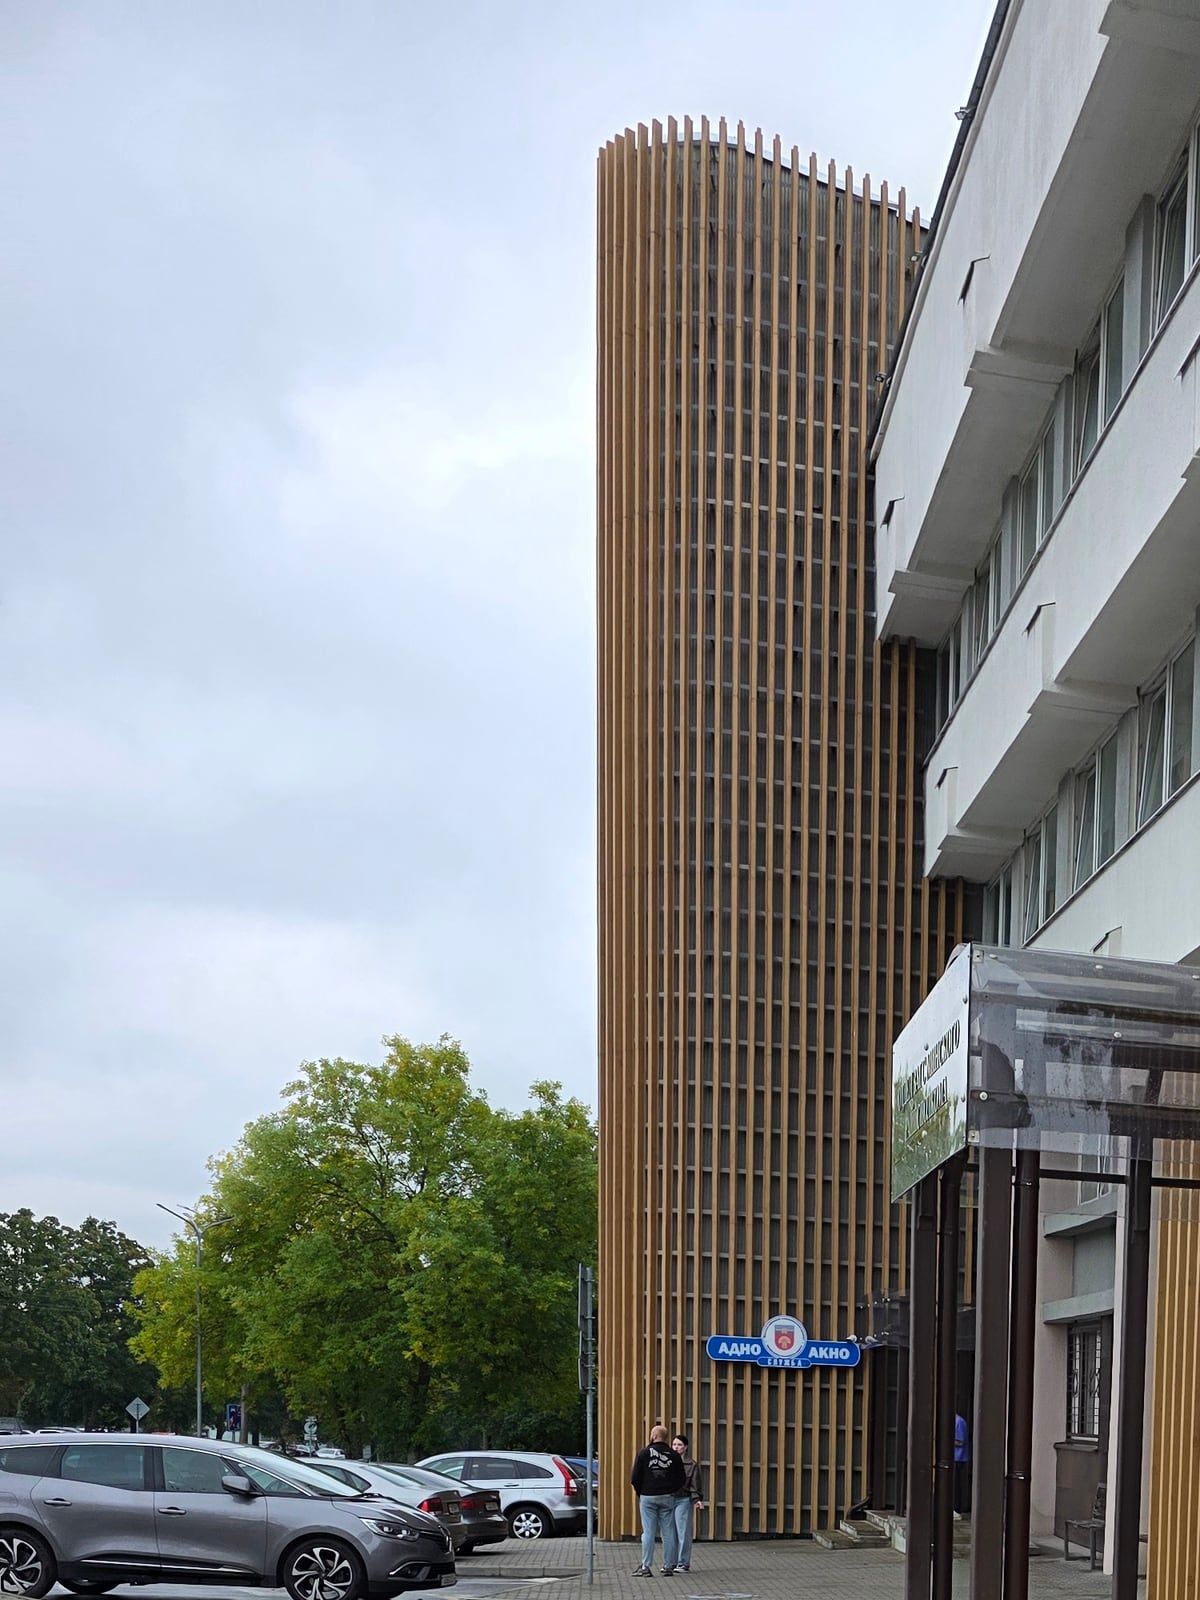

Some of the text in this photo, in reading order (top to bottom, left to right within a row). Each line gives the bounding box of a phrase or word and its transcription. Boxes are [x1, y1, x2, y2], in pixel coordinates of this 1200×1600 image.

[718, 1342, 850, 1360] АДНО АКНО
[767, 1358, 802, 1367] СЛУЖБА
